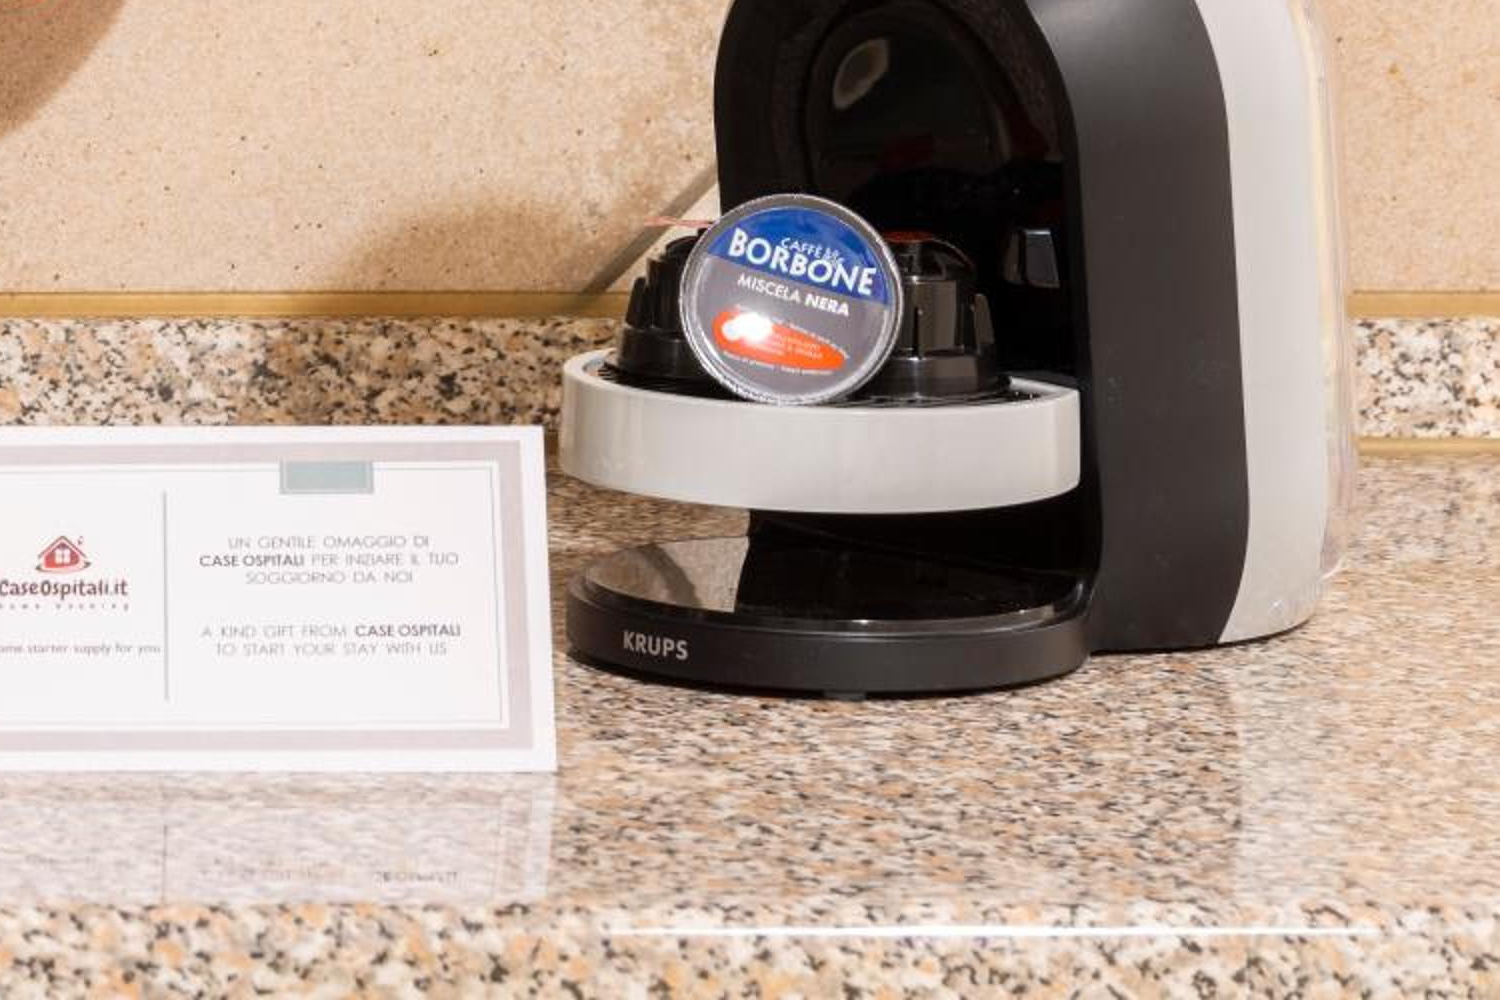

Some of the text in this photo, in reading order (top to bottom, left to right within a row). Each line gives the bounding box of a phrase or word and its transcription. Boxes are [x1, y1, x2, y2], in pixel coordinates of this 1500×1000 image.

[728, 227, 877, 296] BORBONE
[737, 273, 850, 316] MISCELA NERA
[227, 535, 429, 549] UN GENTILE OMAGGIO DI
[199, 552, 459, 567] CASE OSPITALI PER INIZIARE IL TUO
[245, 570, 413, 584] SOGGIORNO DA NOI
[200, 624, 461, 638] A KIND GIFT FROM CASE OSPITALI
[27, 643, 69, 654] starter
[74, 642, 111, 657] supply
[115, 641, 132, 654] for
[138, 645, 161, 658] you
[216, 643, 447, 656] TO START YOUR STAY WITH US
[623, 630, 688, 660] KRUPS
